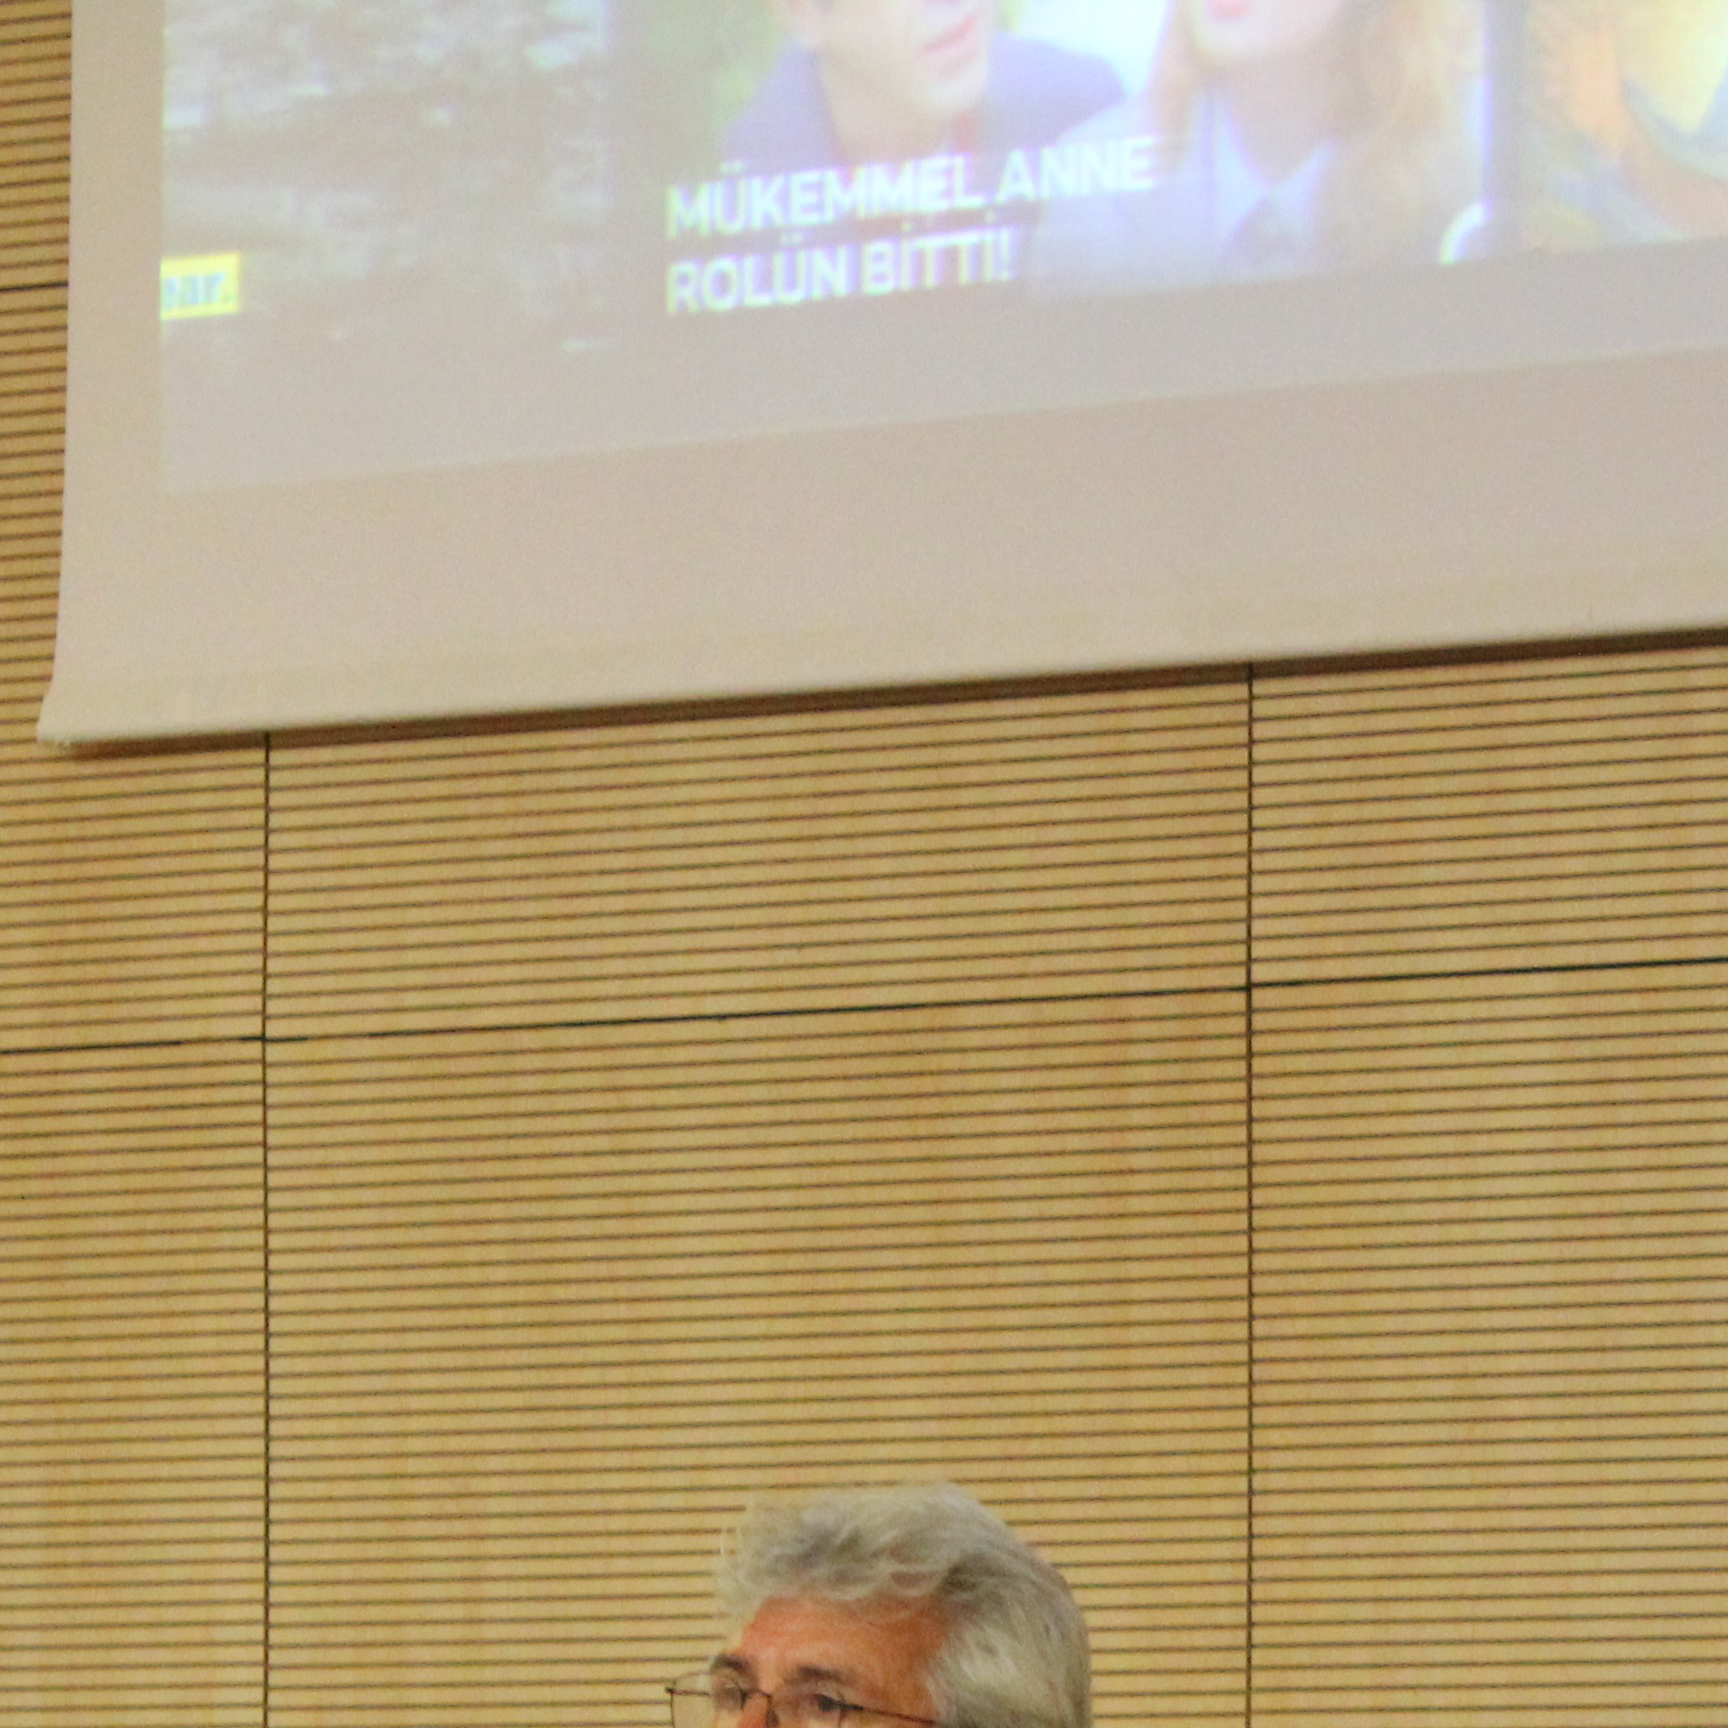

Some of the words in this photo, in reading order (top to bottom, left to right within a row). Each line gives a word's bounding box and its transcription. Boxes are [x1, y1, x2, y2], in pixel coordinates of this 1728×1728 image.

[667, 153, 985, 239] MÜKEMMEL
[997, 134, 1158, 203] ANNE
[667, 231, 849, 313] ROLÜN
[862, 209, 1016, 295] BİTTİ!
